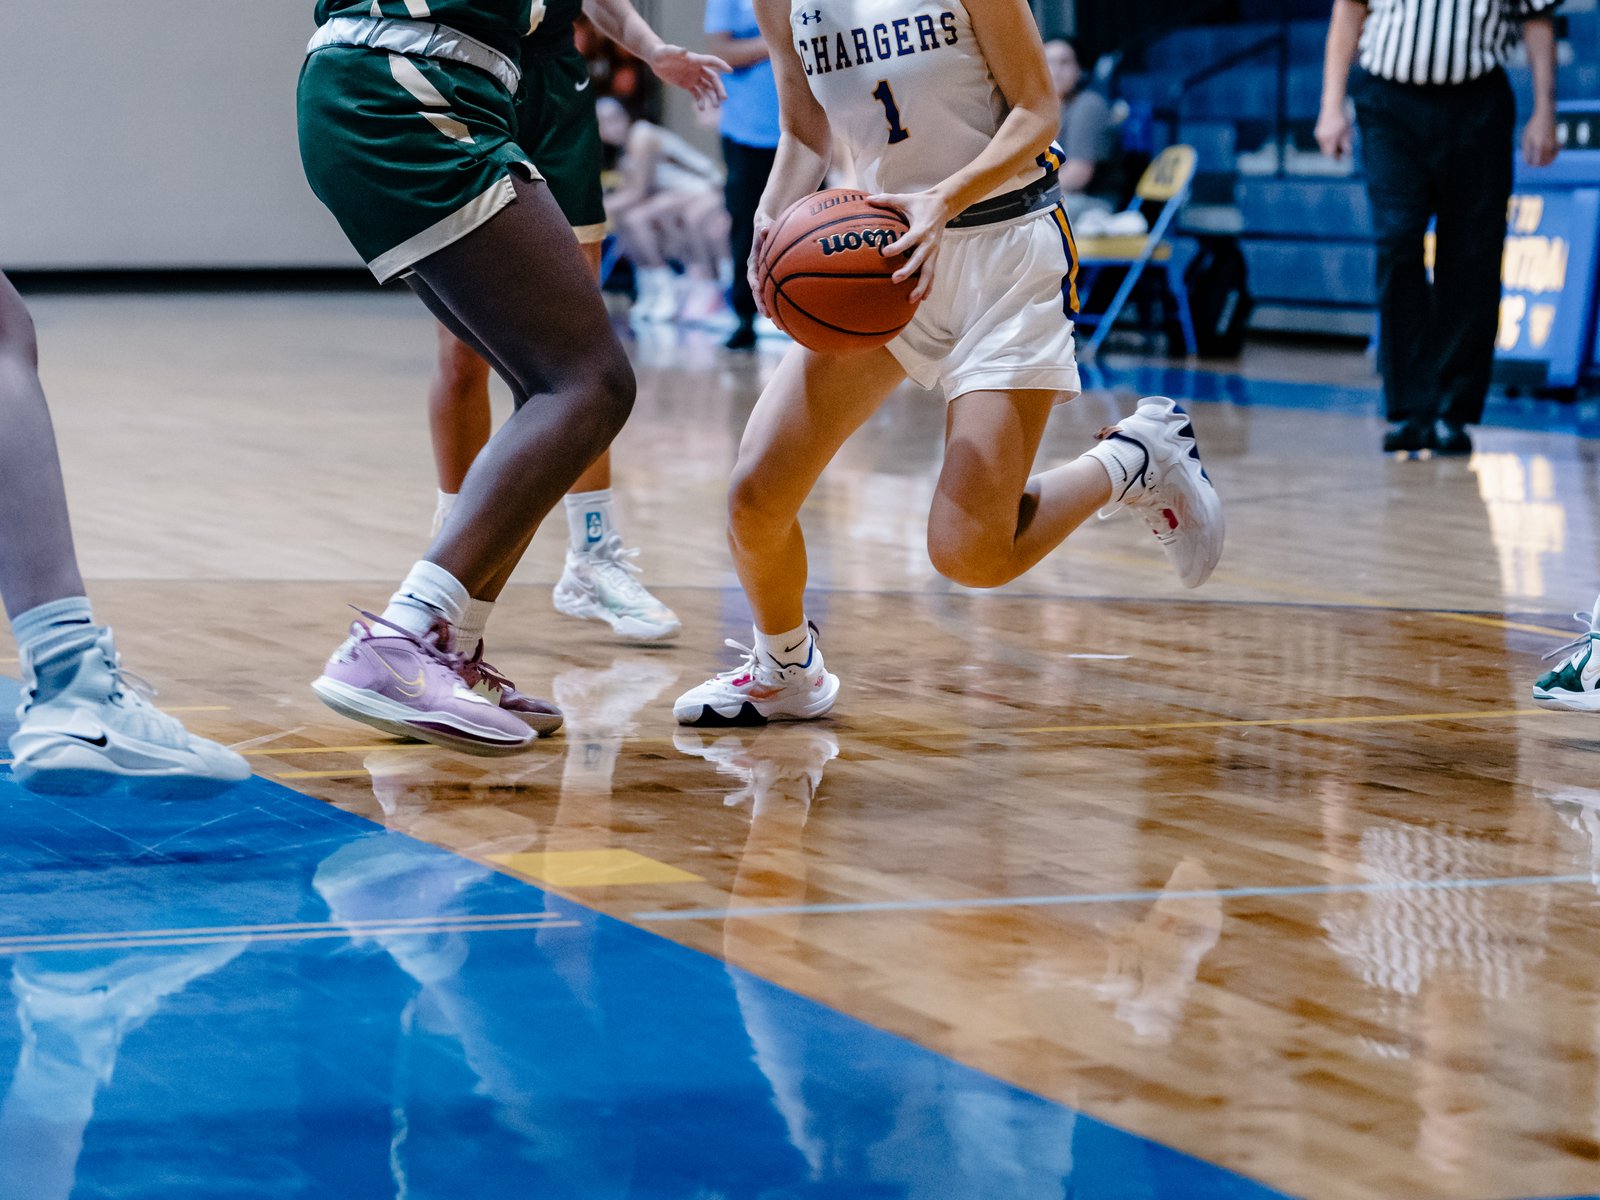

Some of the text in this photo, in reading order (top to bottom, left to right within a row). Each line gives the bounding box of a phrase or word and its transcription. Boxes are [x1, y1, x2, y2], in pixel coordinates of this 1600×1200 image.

[799, 11, 958, 76] CHARGERS
[871, 79, 910, 145] 1
[817, 228, 906, 257] ilson
